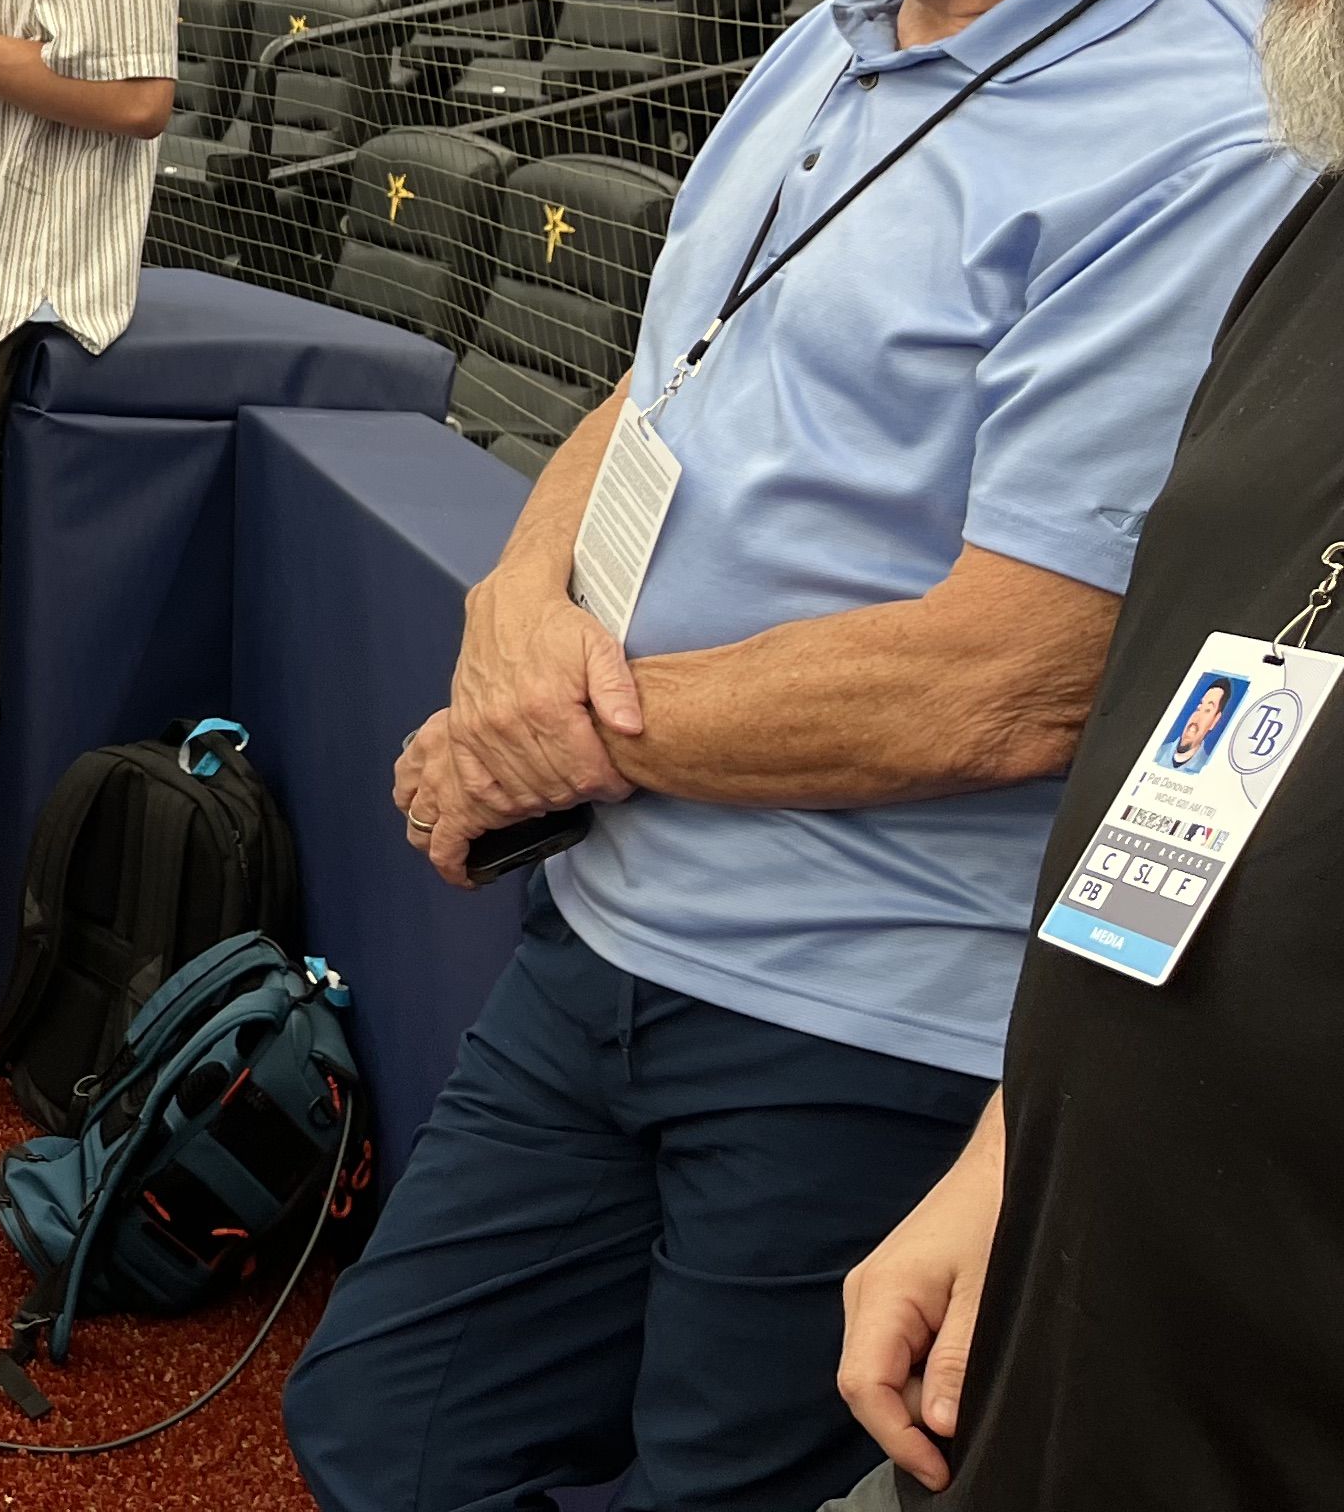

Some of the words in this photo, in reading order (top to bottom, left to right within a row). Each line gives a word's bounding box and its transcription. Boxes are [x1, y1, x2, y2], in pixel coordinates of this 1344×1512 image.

[1248, 704, 1284, 756] TB
[1107, 830, 1151, 851] EVENT
[1158, 847, 1213, 872] ACCESS
[1079, 880, 1102, 901] PB
[1102, 852, 1117, 871] C
[1133, 863, 1154, 885] SL
[1175, 878, 1192, 896] F
[1090, 927, 1126, 951] MEDIA
